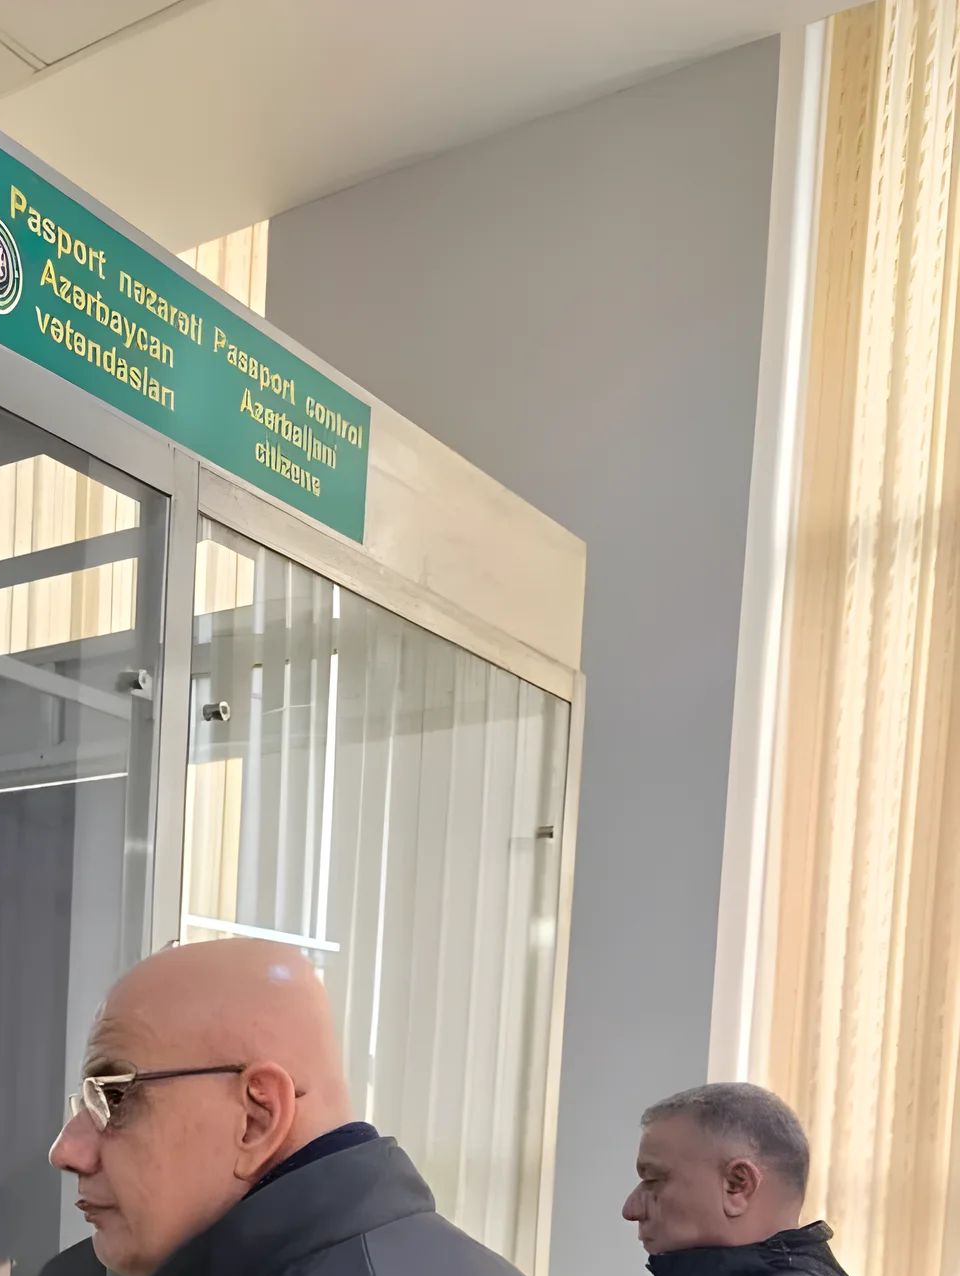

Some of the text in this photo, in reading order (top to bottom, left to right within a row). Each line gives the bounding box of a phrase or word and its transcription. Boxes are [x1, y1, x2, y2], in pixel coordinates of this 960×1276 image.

[10, 185, 106, 279] Pasport
[213, 326, 363, 449] Passport control
